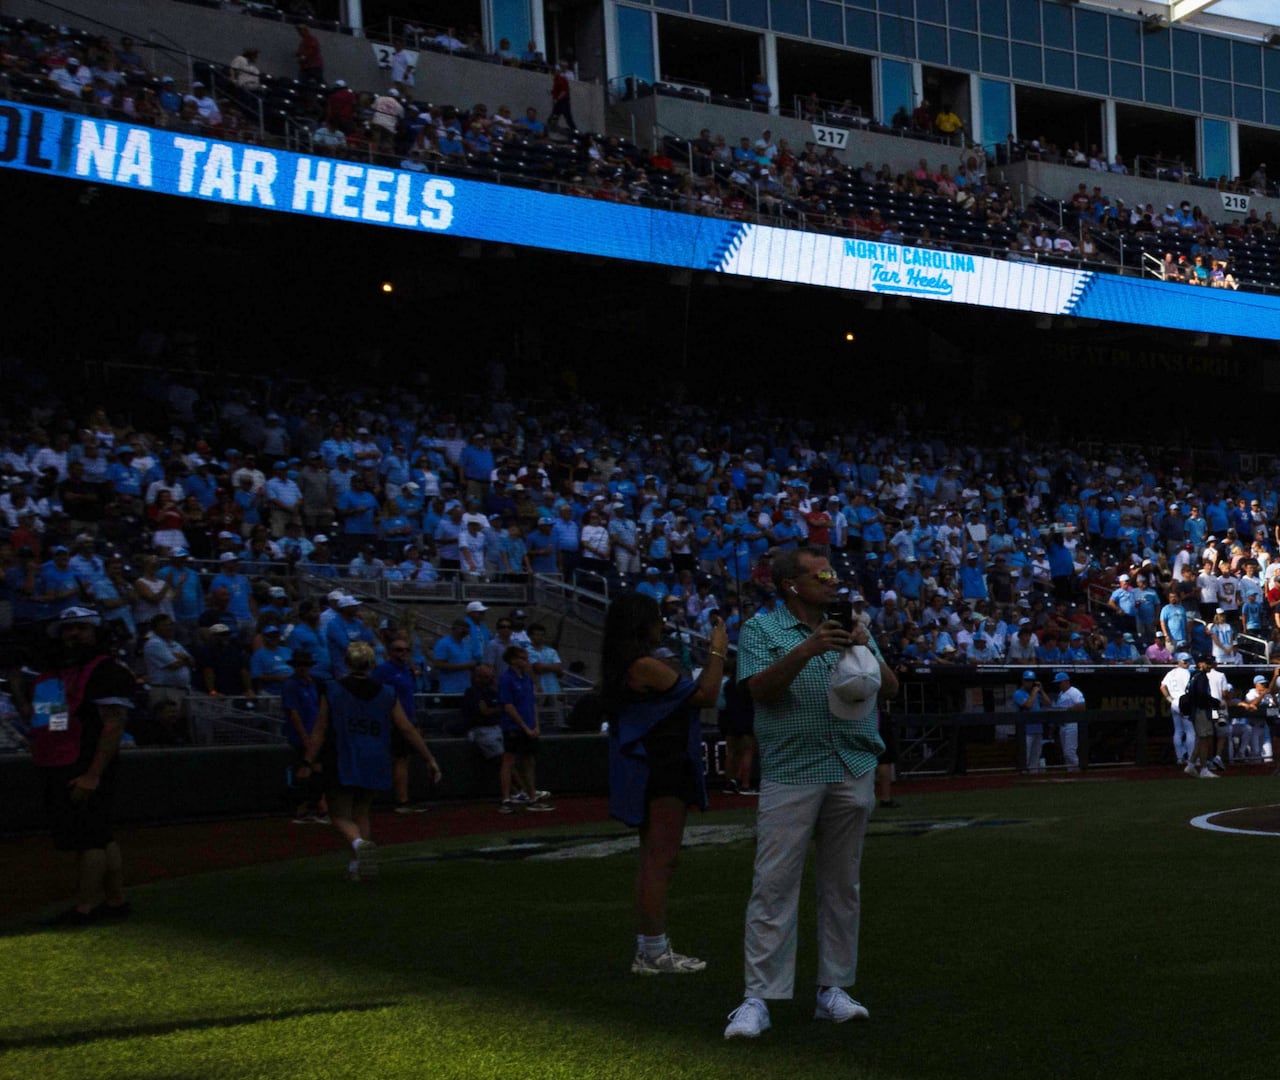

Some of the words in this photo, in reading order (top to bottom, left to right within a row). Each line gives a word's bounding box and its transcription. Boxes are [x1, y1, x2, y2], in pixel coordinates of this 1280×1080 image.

[818, 129, 845, 146] 217
[174, 137, 279, 206] TAR
[291, 157, 457, 231] HEELS
[1225, 196, 1248, 210] 218
[844, 239, 898, 261] NORTH
[902, 246, 976, 273] CAROLINA
[871, 263, 901, 283] Tar
[906, 269, 951, 290] Heels
